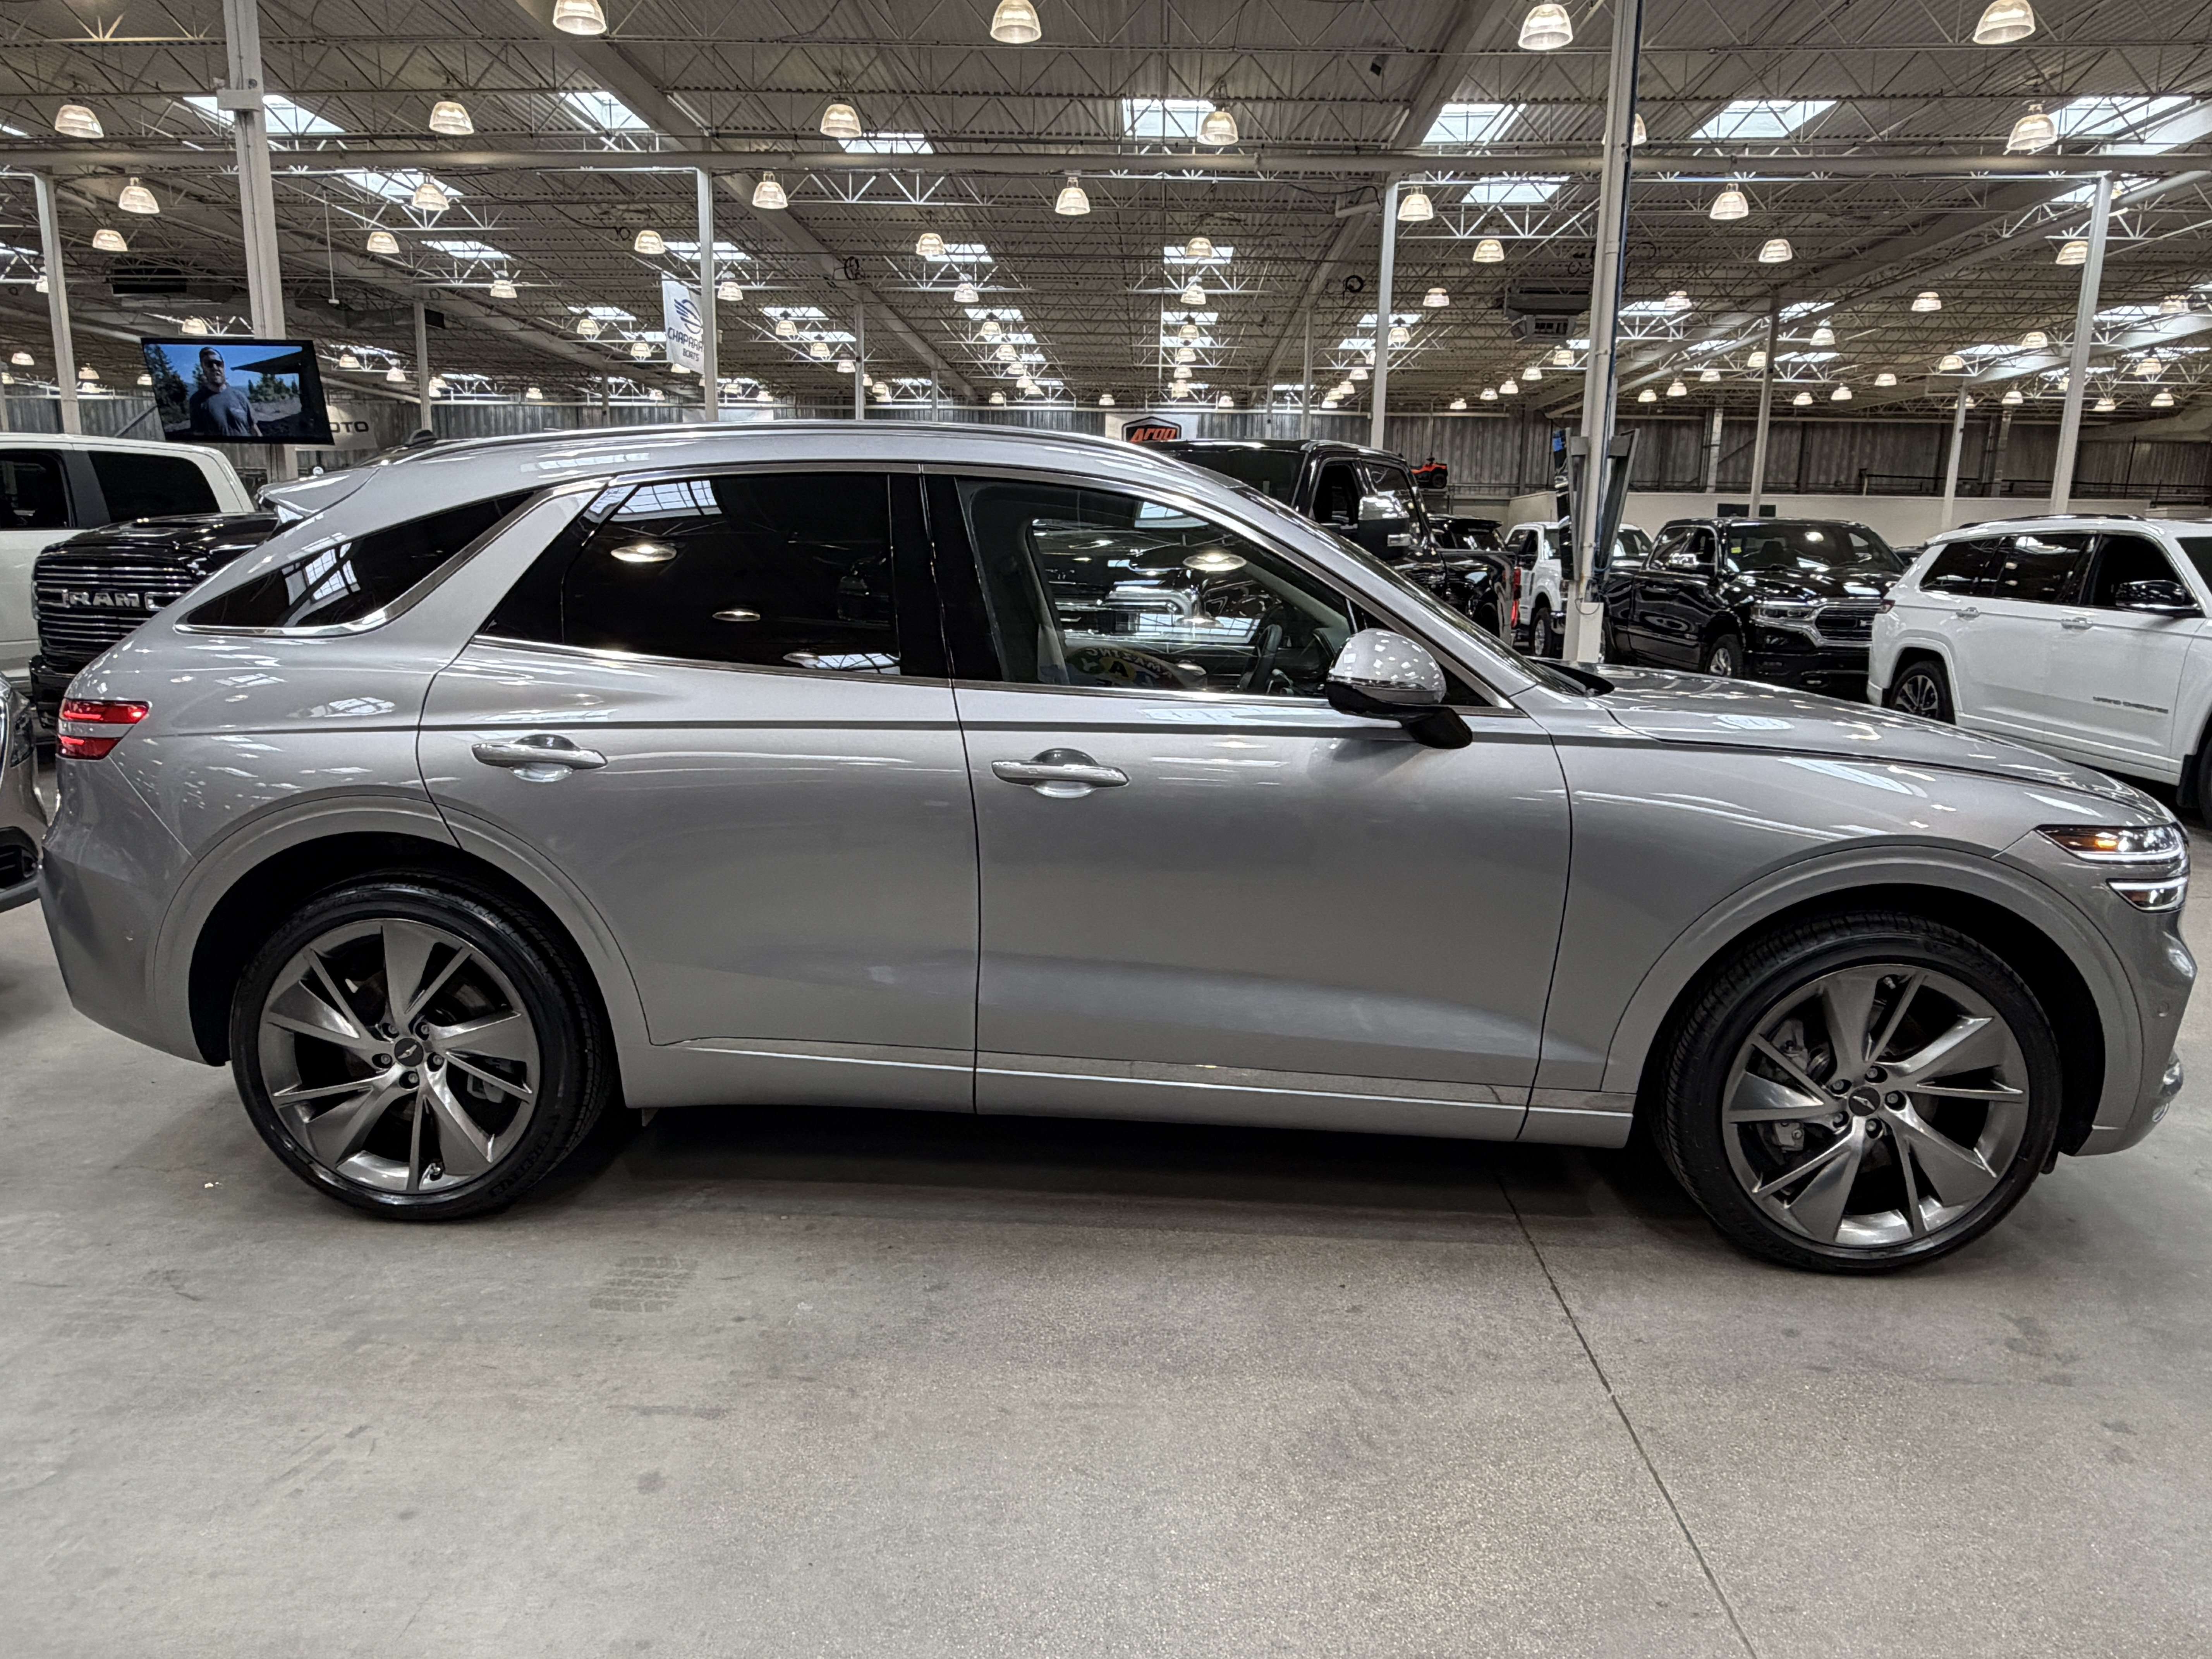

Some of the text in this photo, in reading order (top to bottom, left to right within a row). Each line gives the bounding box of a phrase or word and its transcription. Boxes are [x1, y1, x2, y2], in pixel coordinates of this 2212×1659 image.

[683, 348, 700, 361] BOATS
[329, 421, 369, 433] OTO
[69, 591, 140, 607] RAM
